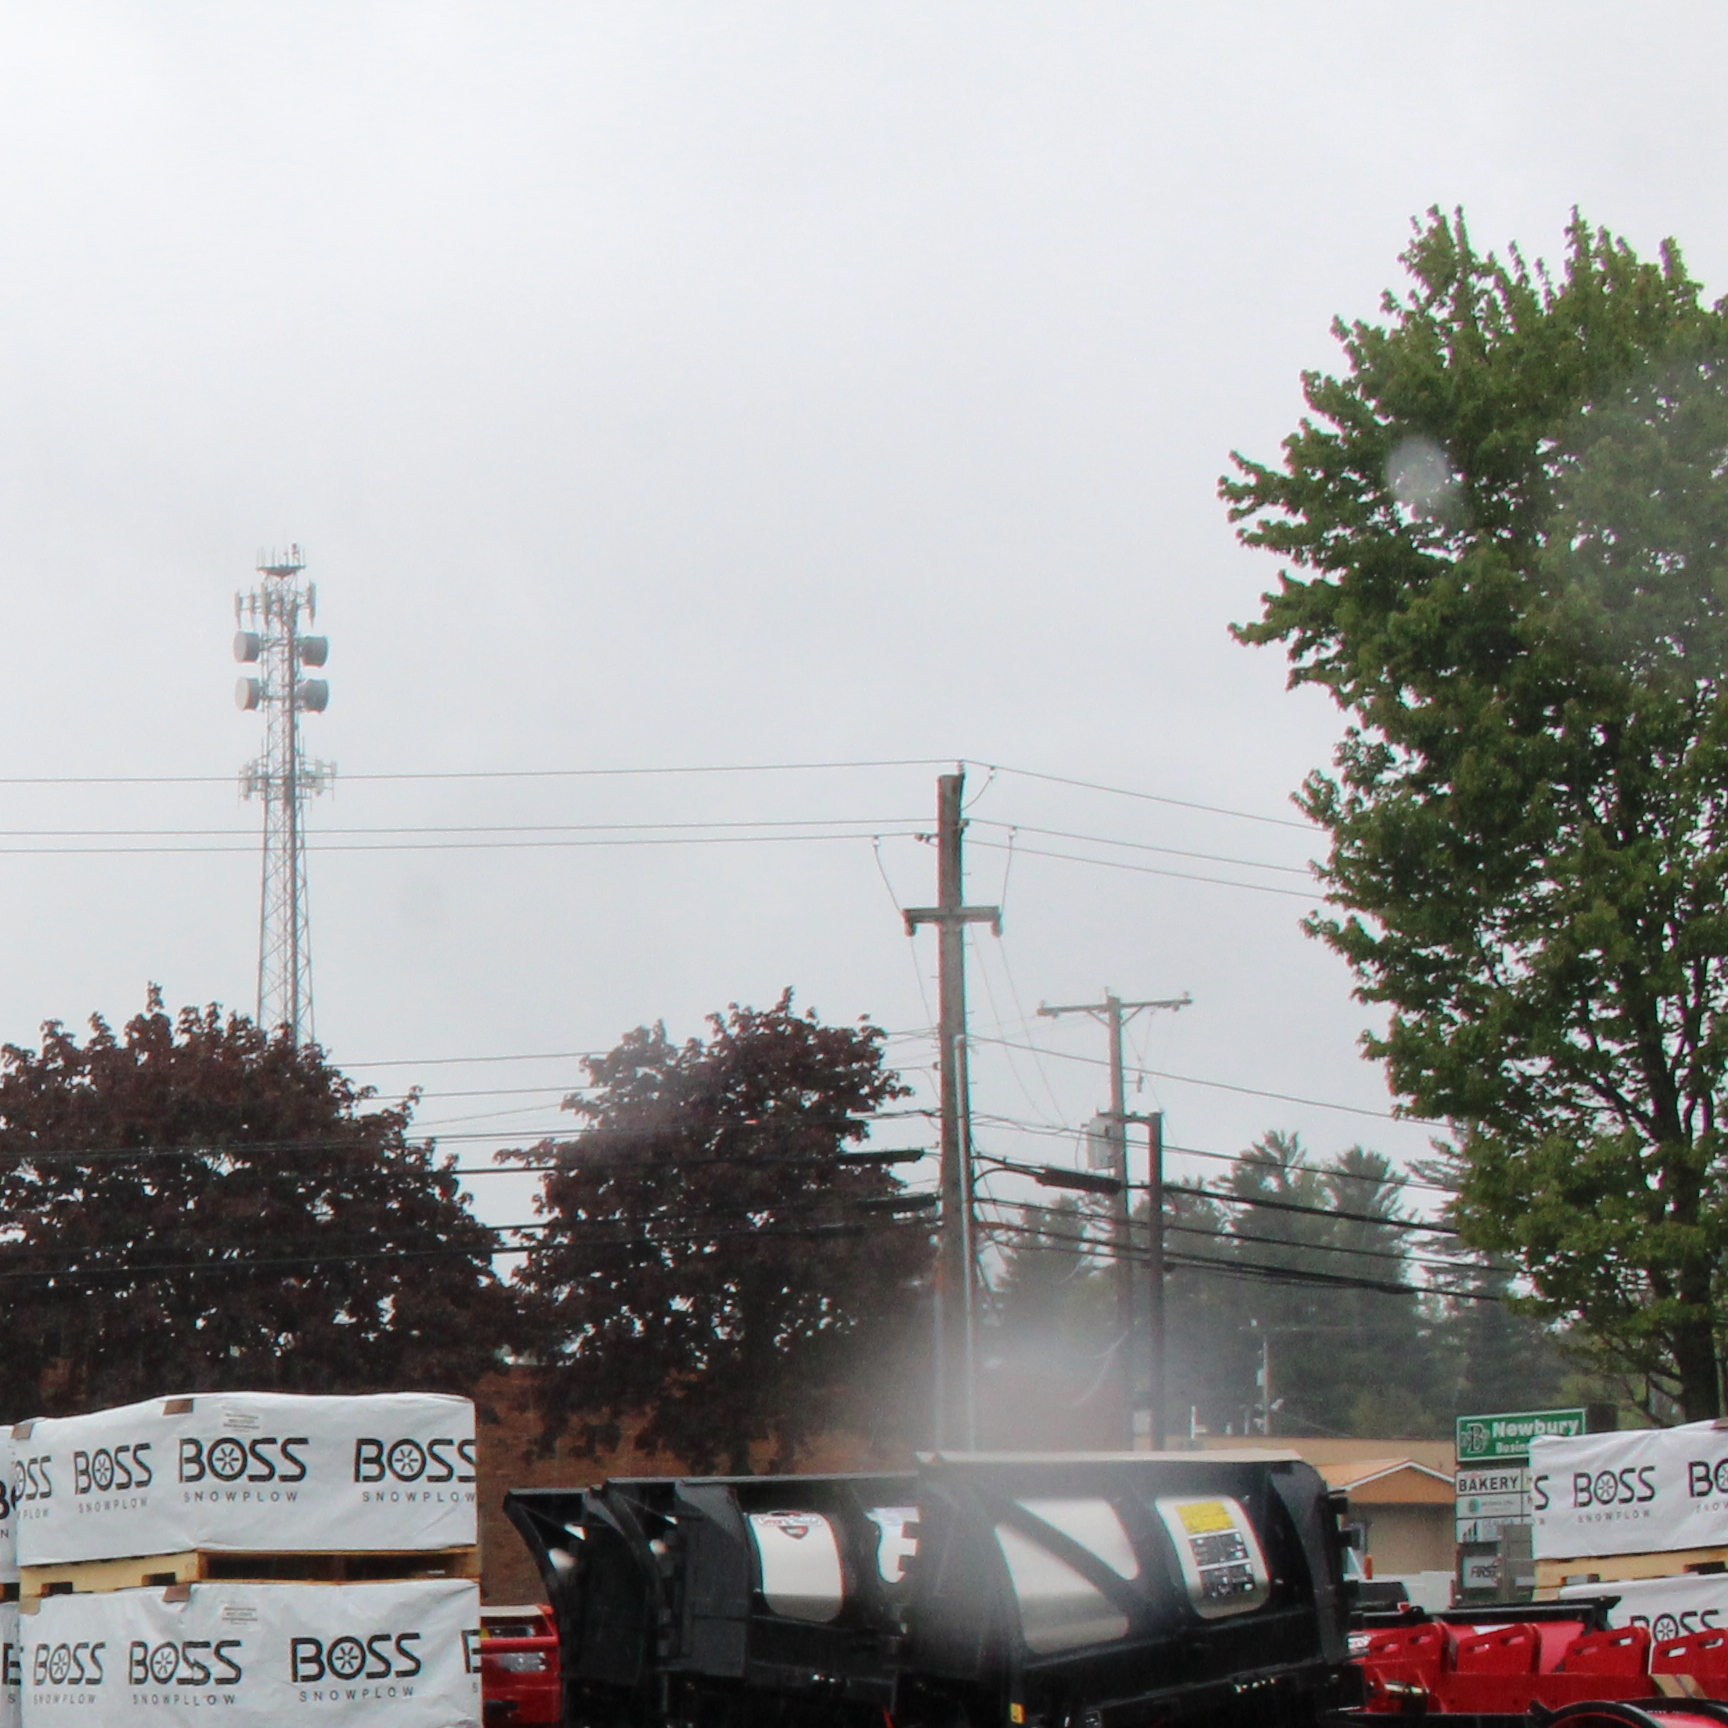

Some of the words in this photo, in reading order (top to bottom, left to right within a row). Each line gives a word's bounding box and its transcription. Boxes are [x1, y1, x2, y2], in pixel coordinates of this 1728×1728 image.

[1492, 1419, 1579, 1438] Newbury
[179, 1437, 309, 1483] BOSS
[1496, 1441, 1529, 1453] Busin
[12, 1456, 52, 1503] OSS
[74, 1443, 152, 1494] BOSS
[1688, 1459, 1728, 1498] BO
[184, 1491, 298, 1502] SNOWPLOW
[362, 1491, 475, 1503] SNOWPLOW
[1459, 1476, 1518, 1492] BAKERY
[1574, 1466, 1656, 1508] BOSS
[79, 1497, 147, 1514] SNOWPLOW
[34, 1642, 105, 1685] BOSS
[290, 1633, 421, 1683] BOSS
[300, 1686, 413, 1702] SNOWPLOW
